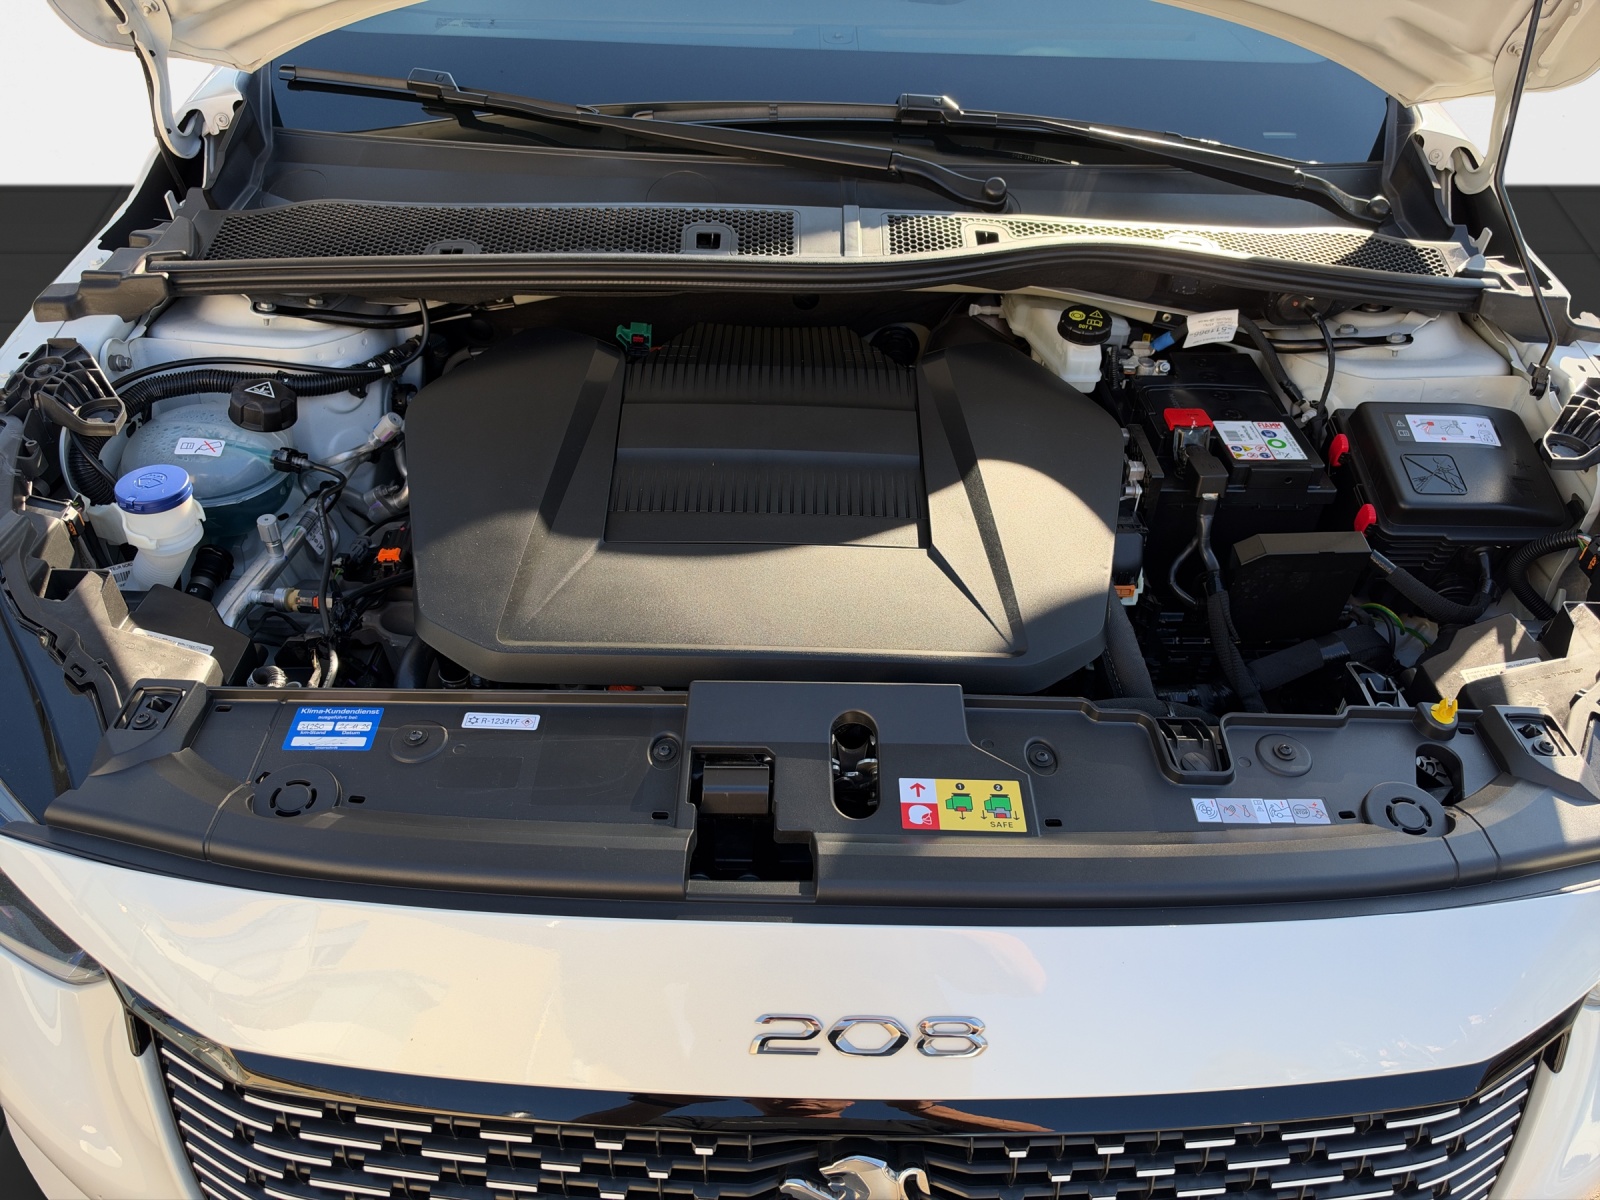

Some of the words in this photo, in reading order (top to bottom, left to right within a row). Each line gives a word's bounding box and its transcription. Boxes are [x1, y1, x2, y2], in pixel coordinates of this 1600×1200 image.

[1257, 422, 1282, 430] FIAMM
[480, 717, 520, 725] R-1234YF
[748, 1013, 989, 1058] 208
